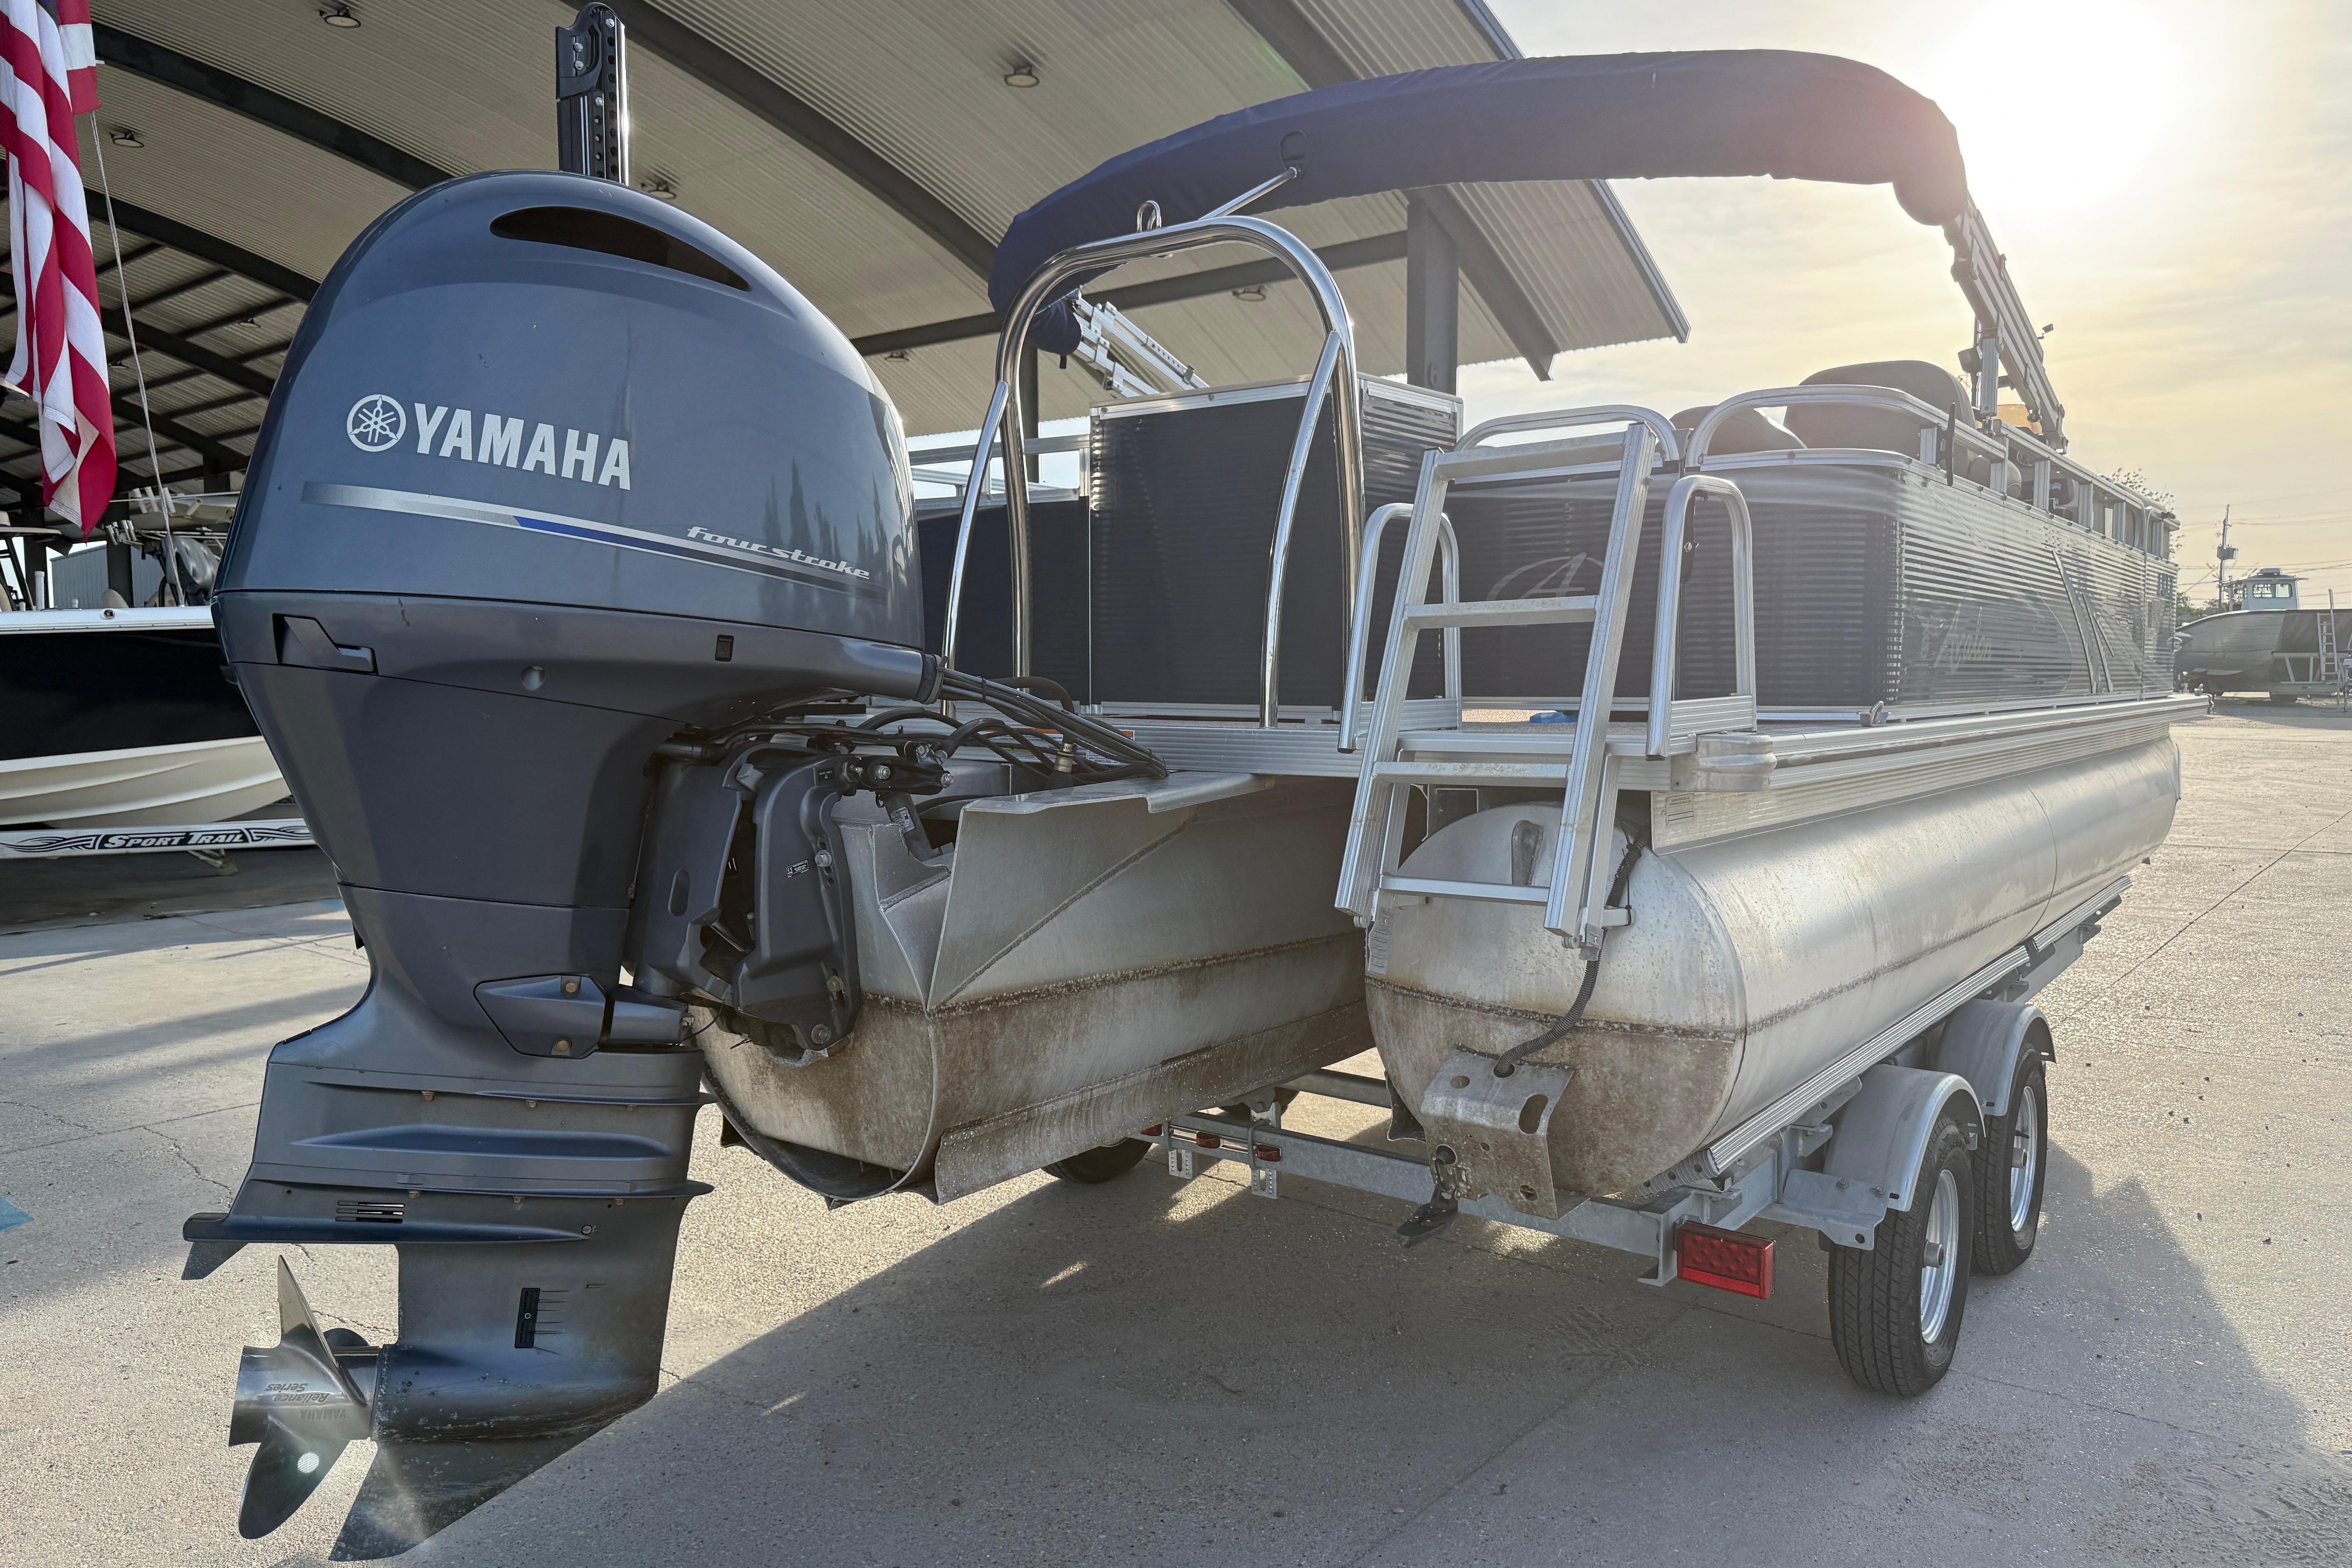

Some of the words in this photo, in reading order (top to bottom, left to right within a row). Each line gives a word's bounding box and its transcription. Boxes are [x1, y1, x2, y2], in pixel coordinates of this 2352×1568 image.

[414, 403, 631, 490] YAMAHA
[688, 526, 767, 552] four
[772, 548, 870, 579] stroke
[105, 833, 185, 848] SPORT
[187, 830, 243, 844] TRAIL
[266, 1383, 308, 1393] Series
[273, 1393, 329, 1403] Reliance
